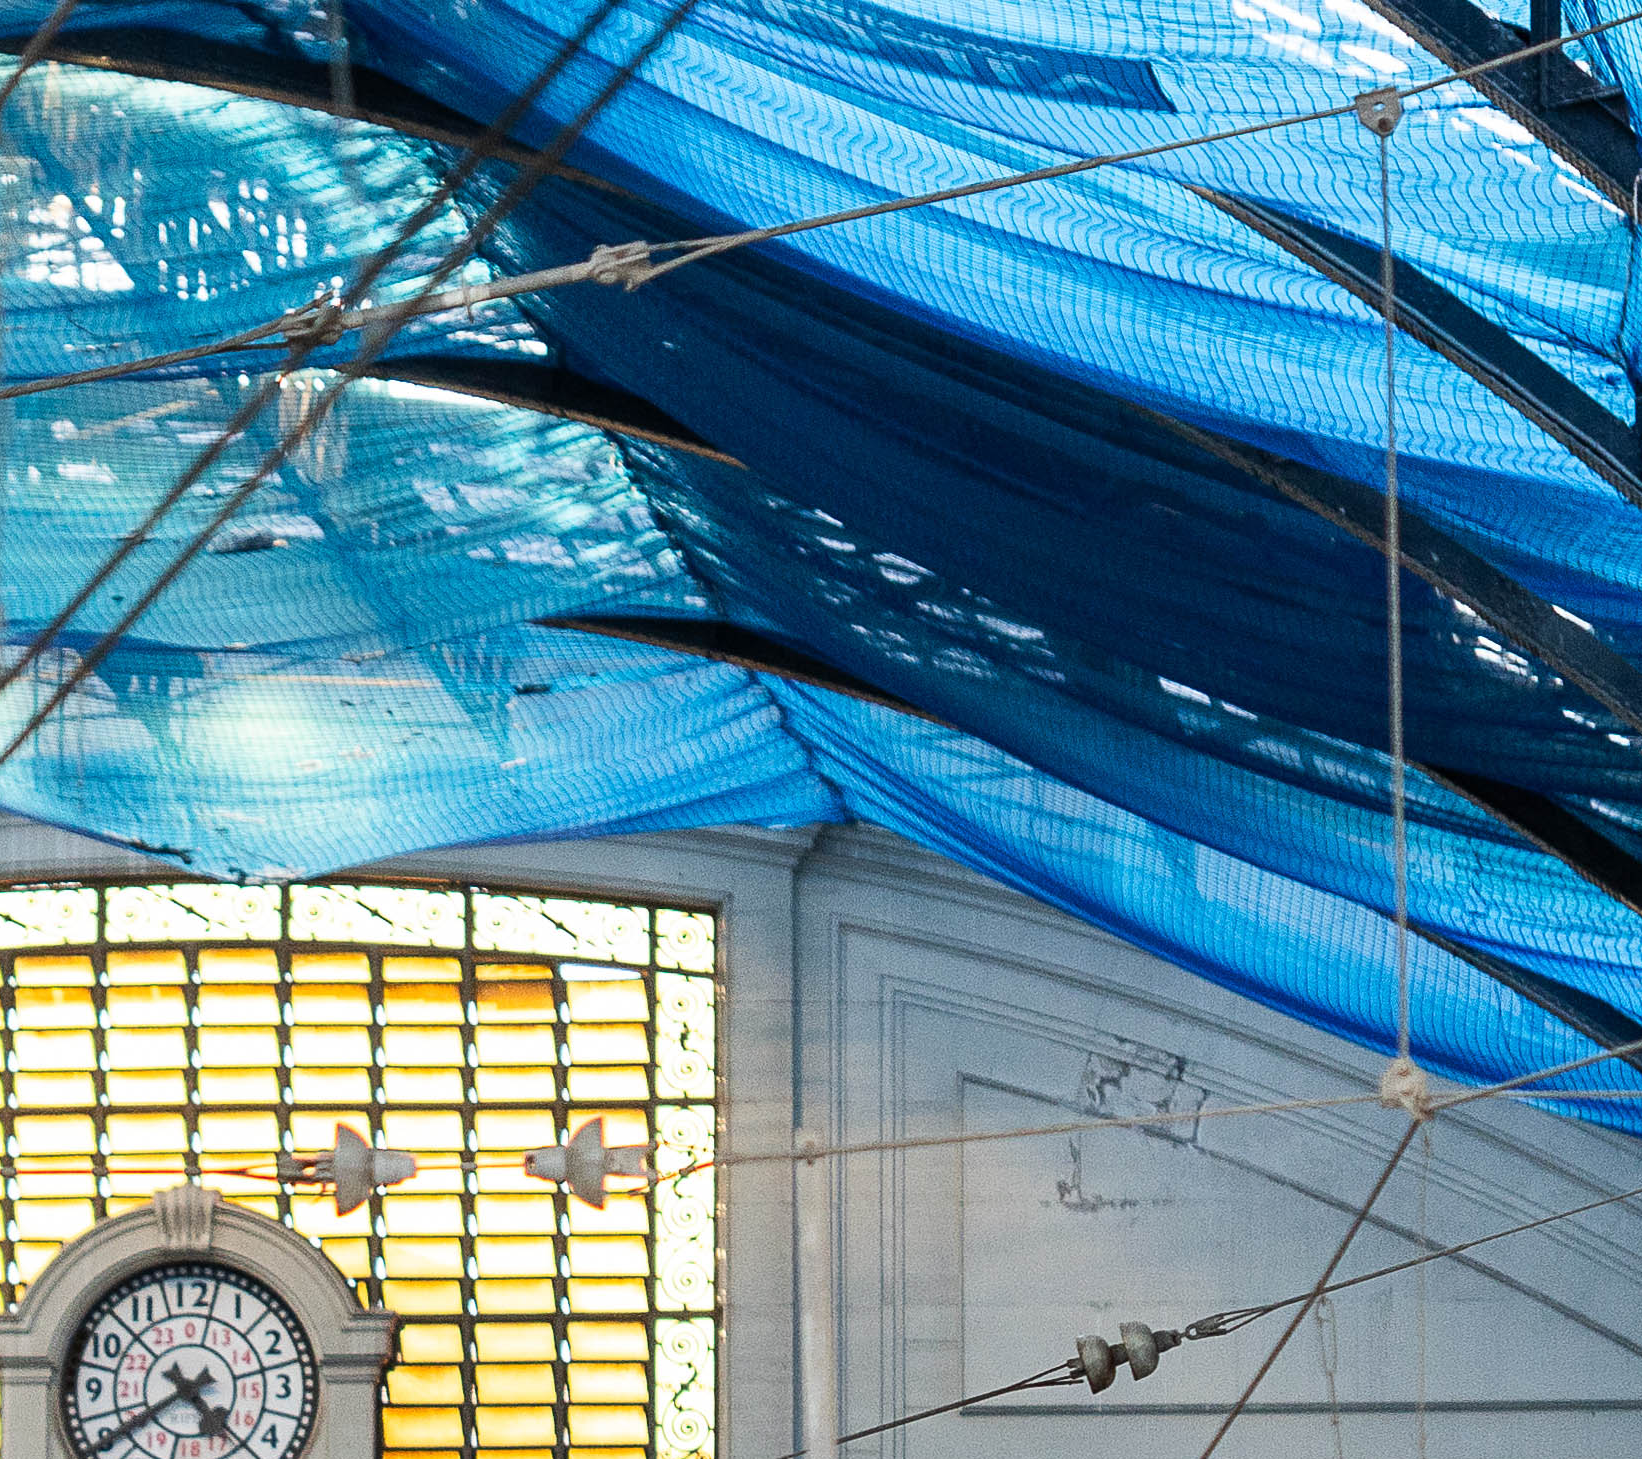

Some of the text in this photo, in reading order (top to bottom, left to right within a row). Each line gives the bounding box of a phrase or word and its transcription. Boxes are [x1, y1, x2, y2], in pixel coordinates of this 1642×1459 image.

[177, 1282, 208, 1307] 12
[132, 1295, 153, 1322] 11
[235, 1294, 241, 1319] 1
[152, 1327, 174, 1345] 23
[185, 1322, 196, 1338] 0
[212, 1330, 231, 1346] 13
[93, 1333, 121, 1358] 10
[266, 1330, 282, 1354] 2
[125, 1354, 147, 1371] 22
[232, 1350, 252, 1365] 14
[86, 1377, 102, 1401] 9
[119, 1383, 139, 1397] 21
[241, 1383, 261, 1399] 15
[276, 1374, 291, 1399] 3
[234, 1411, 255, 1425] 16
[147, 1432, 167, 1448] 19
[262, 1425, 278, 1449] 4
[181, 1441, 200, 1457] 18
